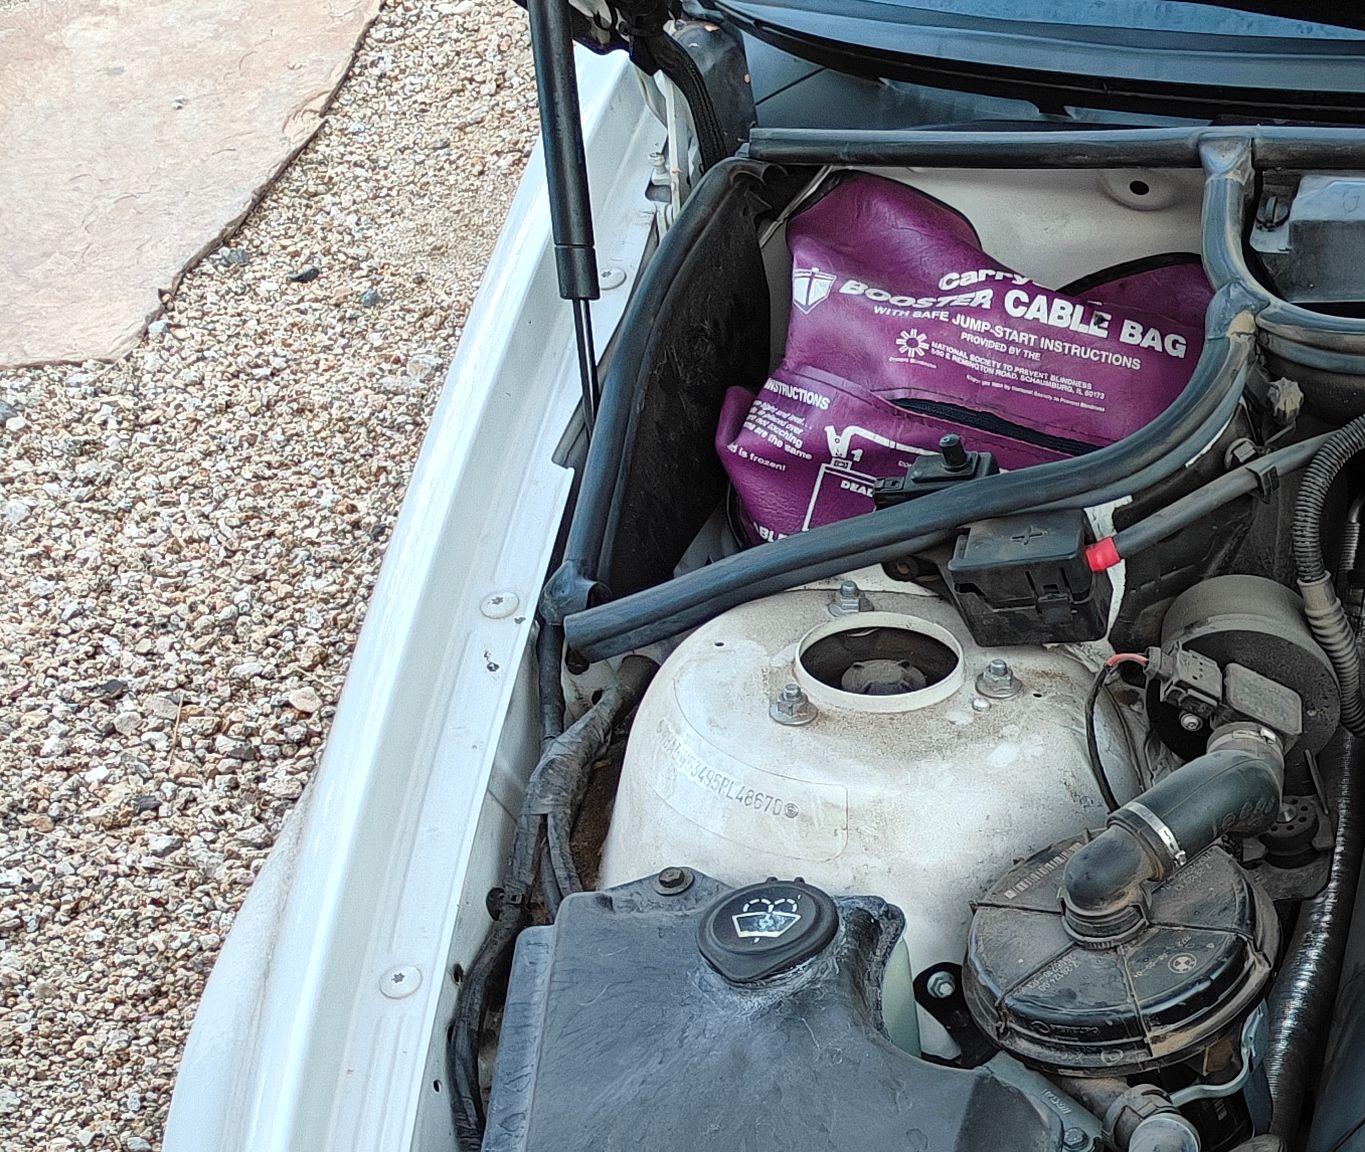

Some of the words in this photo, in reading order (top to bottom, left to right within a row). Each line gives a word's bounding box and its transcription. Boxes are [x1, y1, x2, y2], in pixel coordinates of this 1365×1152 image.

[839, 280, 994, 309] BOOSTER
[1004, 290, 1112, 338] CABLE
[1119, 320, 1187, 359] BAG
[873, 305, 910, 317] WITH
[912, 310, 950, 321] SAFE
[952, 313, 1038, 348] JUMP-START
[1040, 337, 1142, 370] INSTRUCTIONS
[960, 332, 1007, 355] PROVIDED
[1007, 345, 1023, 357] BY
[1023, 349, 1041, 361] THE
[969, 354, 1001, 369] SOCIETY
[1002, 362, 1013, 371] TO
[1014, 365, 1048, 380] PREVENT
[1050, 373, 1093, 390] BLINDNESS
[851, 449, 863, 462] 1
